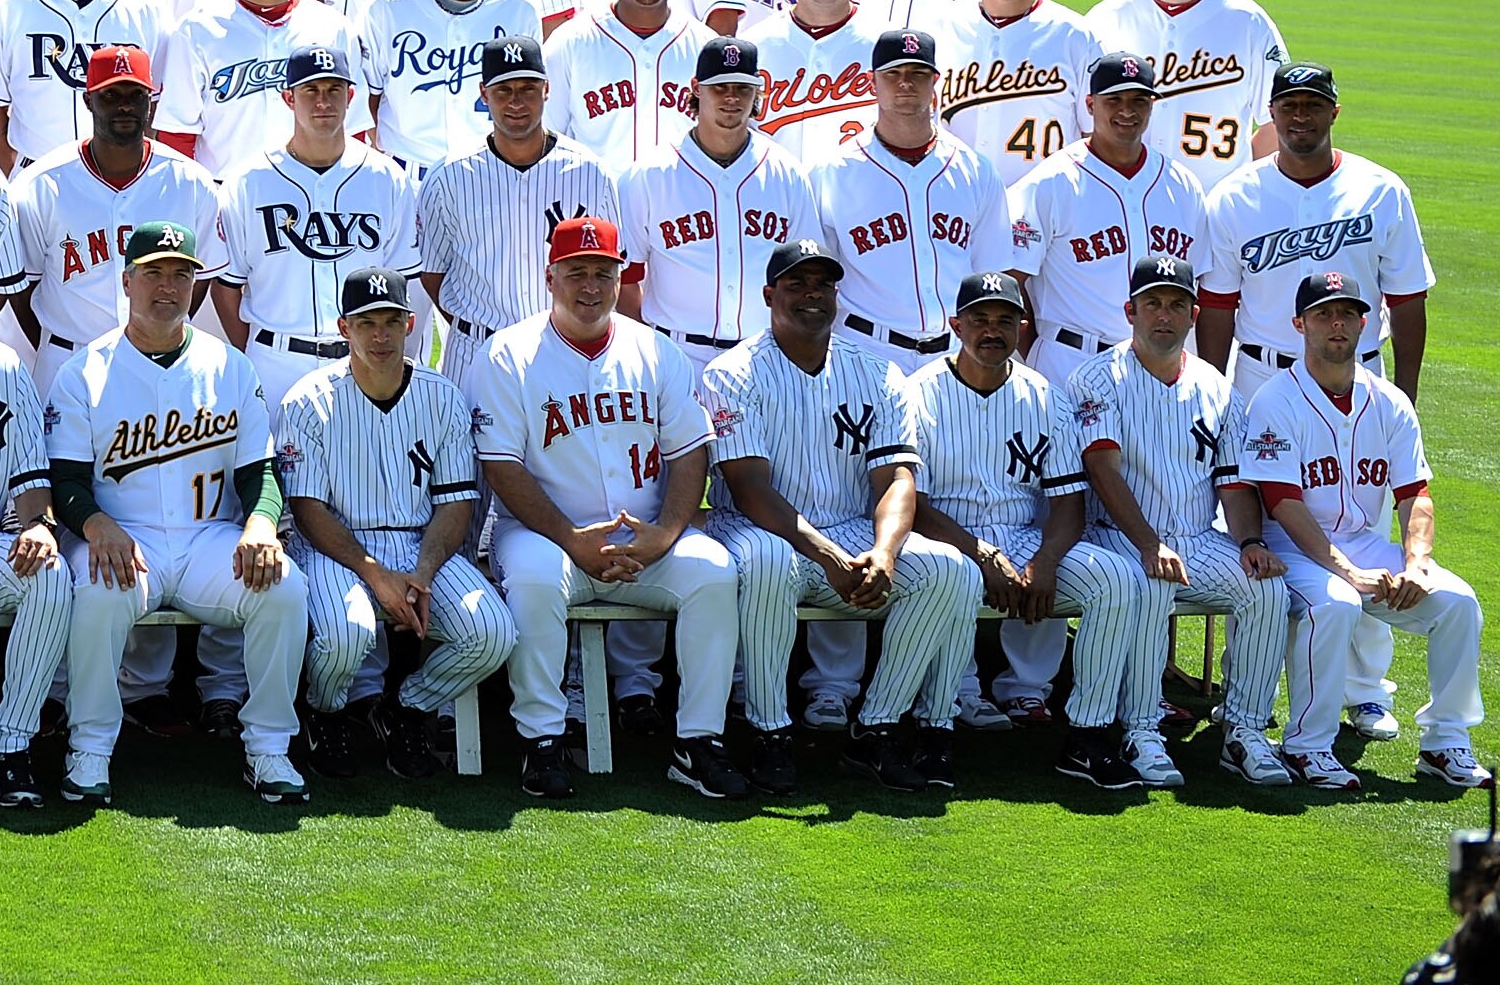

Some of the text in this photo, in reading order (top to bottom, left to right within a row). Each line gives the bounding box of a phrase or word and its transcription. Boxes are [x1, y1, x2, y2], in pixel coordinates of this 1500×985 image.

[390, 24, 506, 95] Roya
[502, 42, 525, 64] NY
[1152, 47, 1244, 99] letics
[213, 57, 290, 104] Jay
[585, 81, 700, 120] RED SO
[1005, 118, 1063, 162] 40
[1180, 111, 1239, 161] 53
[59, 220, 136, 283] ANG
[254, 200, 382, 264] RAYS
[658, 210, 715, 250] RED
[848, 212, 909, 255] RED
[1068, 224, 1194, 264] RED SOX
[368, 274, 389, 296] NY
[981, 272, 1004, 292] NY
[1155, 256, 1177, 276] NY
[102, 405, 240, 483] Athletics
[832, 402, 875, 456] NY
[1273, 442, 1291, 452] GAME
[407, 439, 435, 487] N
[627, 438, 661, 490] 14
[1005, 430, 1050, 484] NY
[1356, 457, 1390, 488] SO
[191, 469, 226, 521] 17
